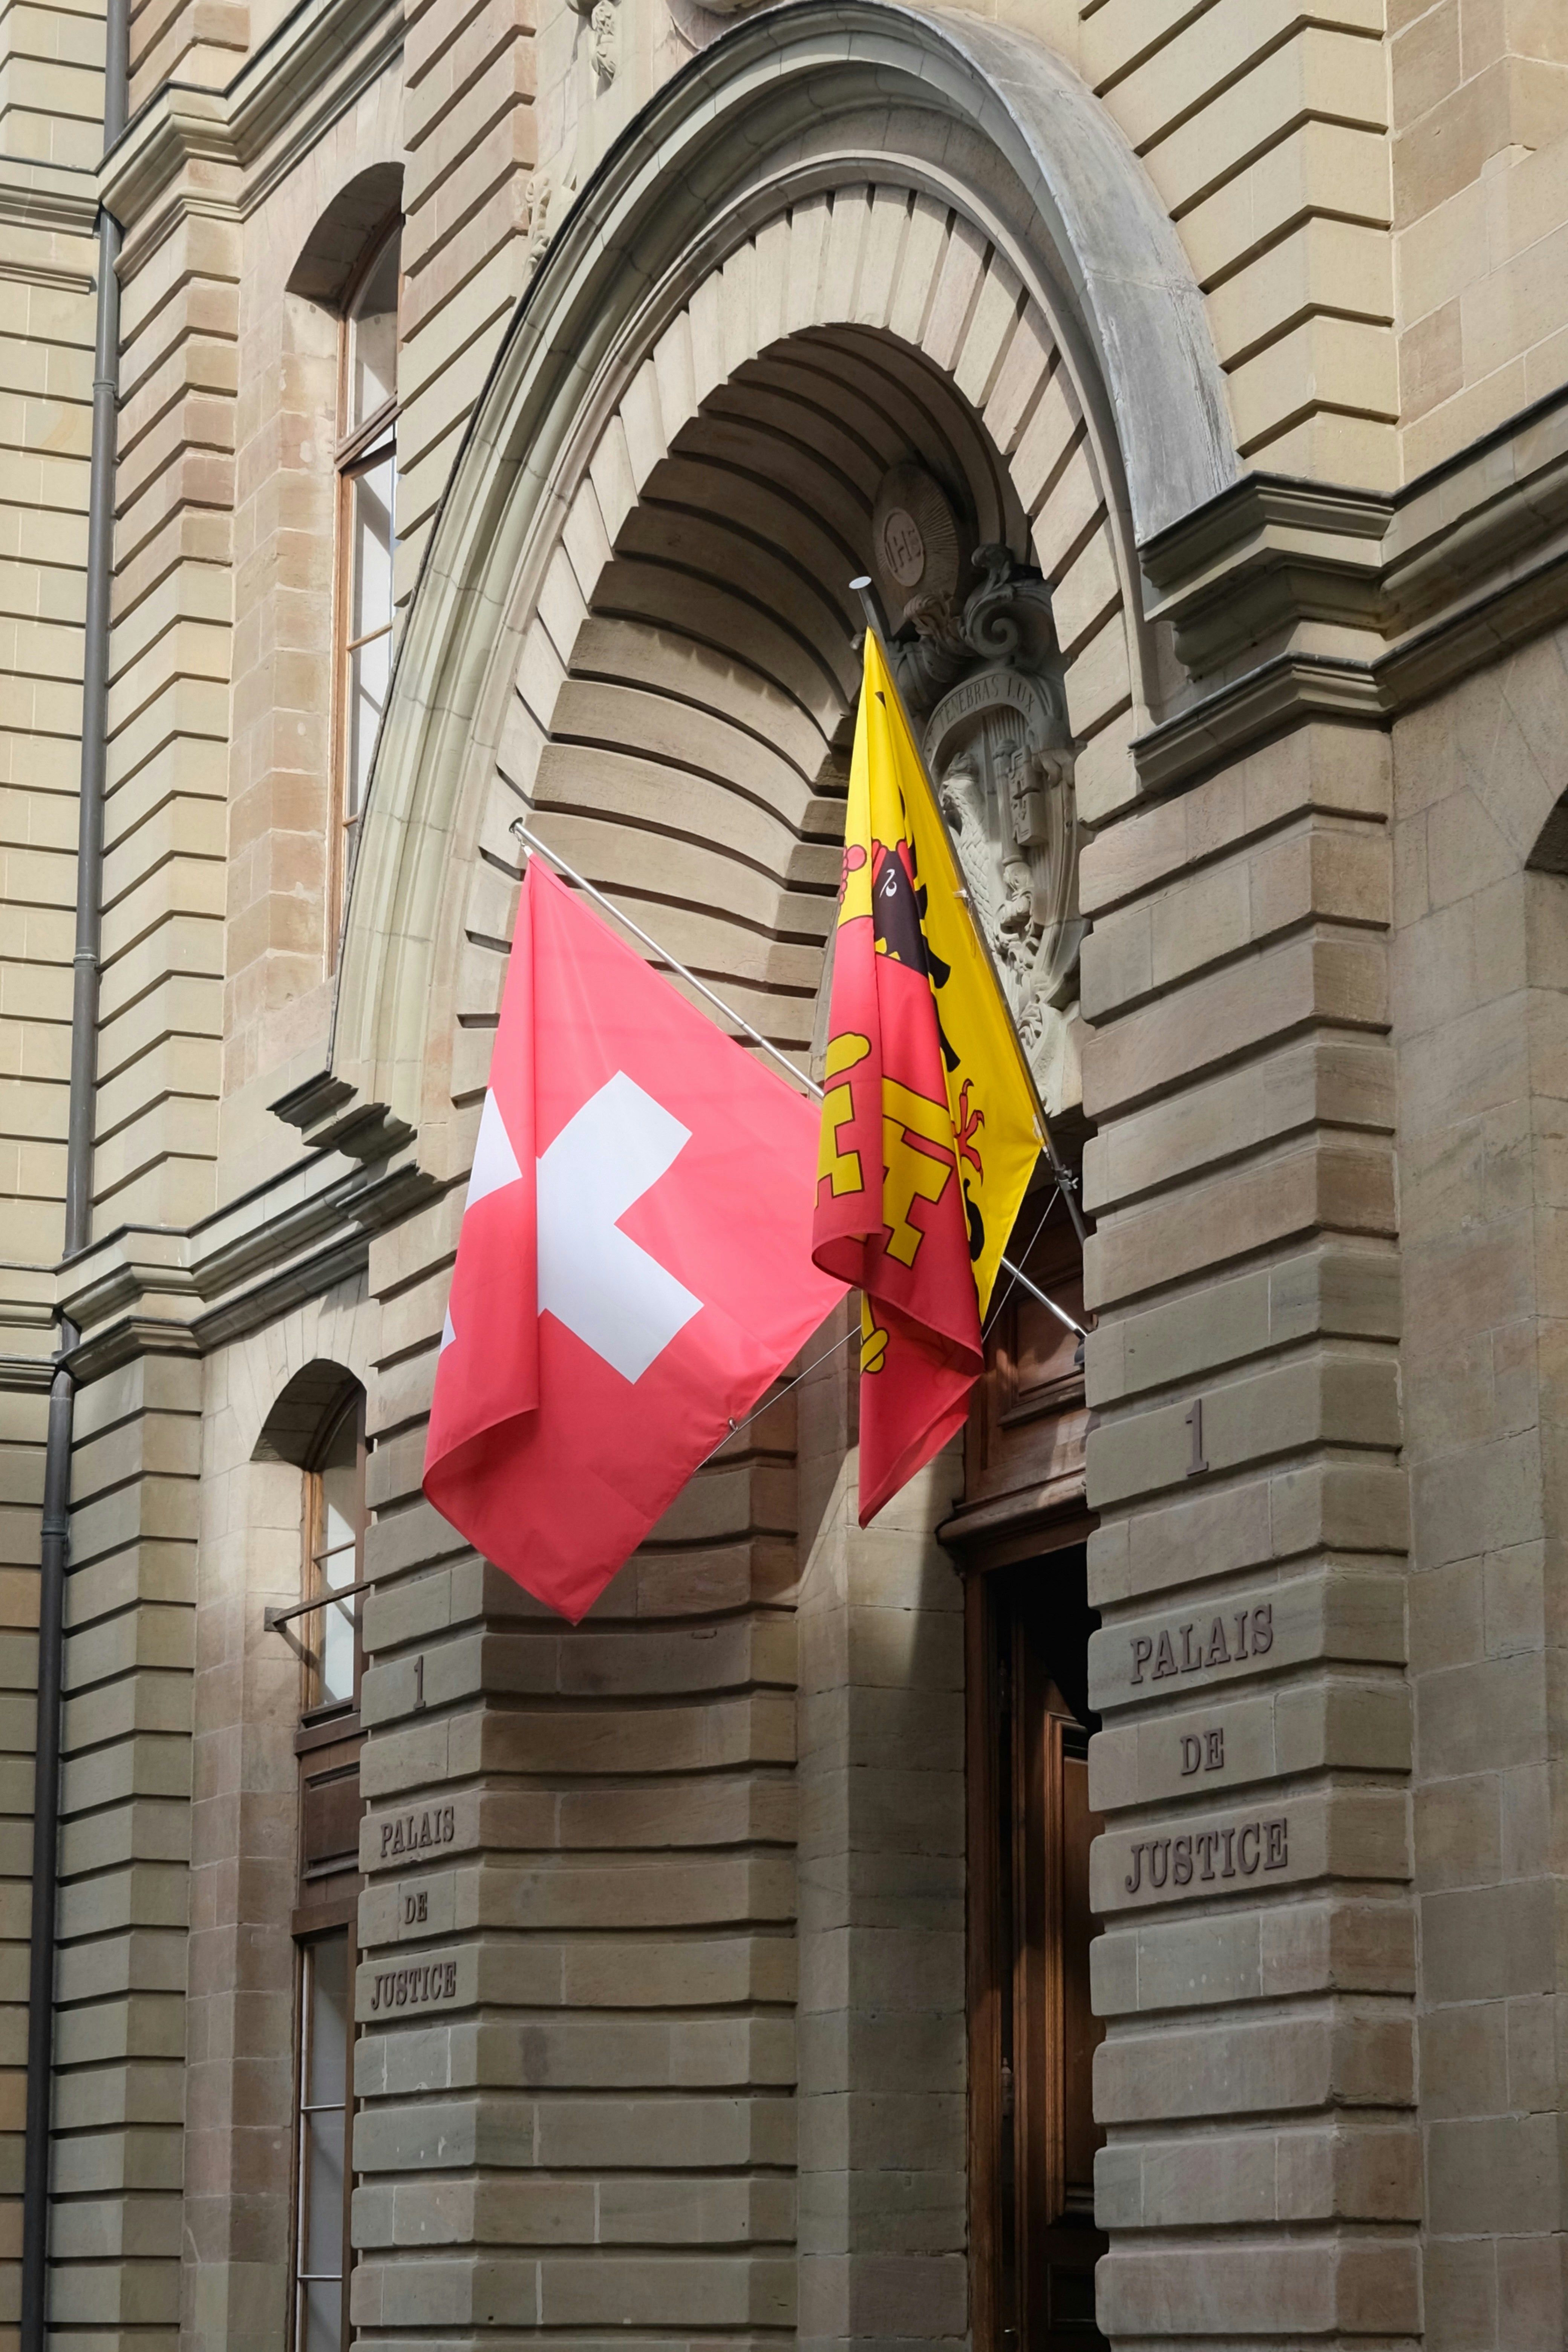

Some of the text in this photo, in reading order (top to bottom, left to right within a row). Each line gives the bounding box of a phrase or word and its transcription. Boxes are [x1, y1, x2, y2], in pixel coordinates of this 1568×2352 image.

[937, 675, 998, 731] TENEBRAS
[1008, 678, 1035, 712] LUX
[1185, 1398, 1209, 1476] 1
[1130, 1603, 1273, 1684] PALAIS
[414, 1655, 426, 1710] 1
[1180, 1728, 1224, 1776] DE
[381, 1806, 455, 1858] PALAIS
[1125, 1818, 1288, 1893] JUSTICE
[405, 1891, 427, 1924] DE
[371, 1961, 456, 2010] JUSTICE
